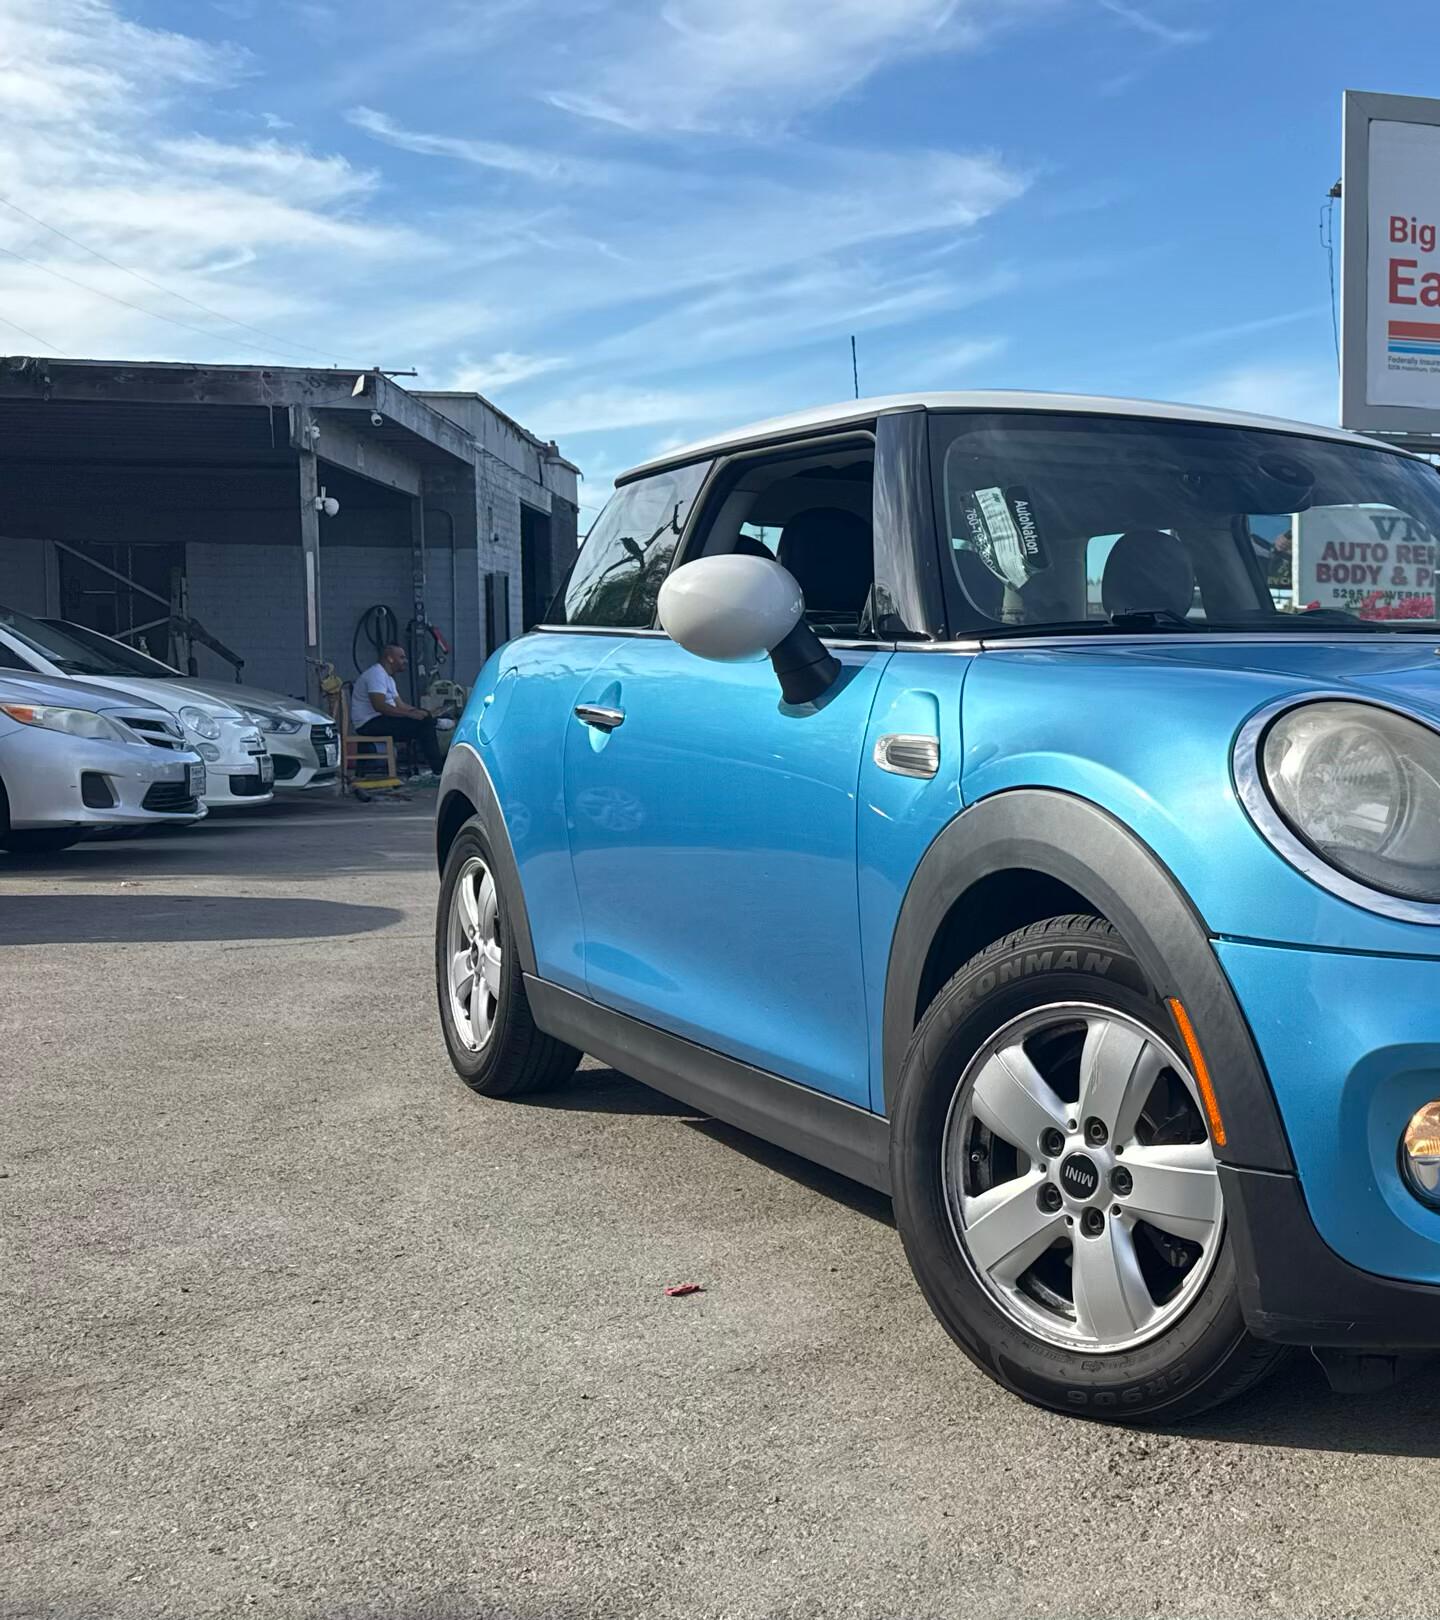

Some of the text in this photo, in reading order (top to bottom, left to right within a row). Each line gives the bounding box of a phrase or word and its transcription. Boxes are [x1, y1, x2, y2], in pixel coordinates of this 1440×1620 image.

[1389, 215, 1436, 252] Big
[1388, 356, 1418, 366] Federally
[1014, 500, 1039, 555] AutoNation
[1321, 541, 1388, 563] AUTO
[1316, 562, 1382, 586] BODY
[1391, 567, 1409, 586] &
[1065, 1165, 1094, 1188] MINI
